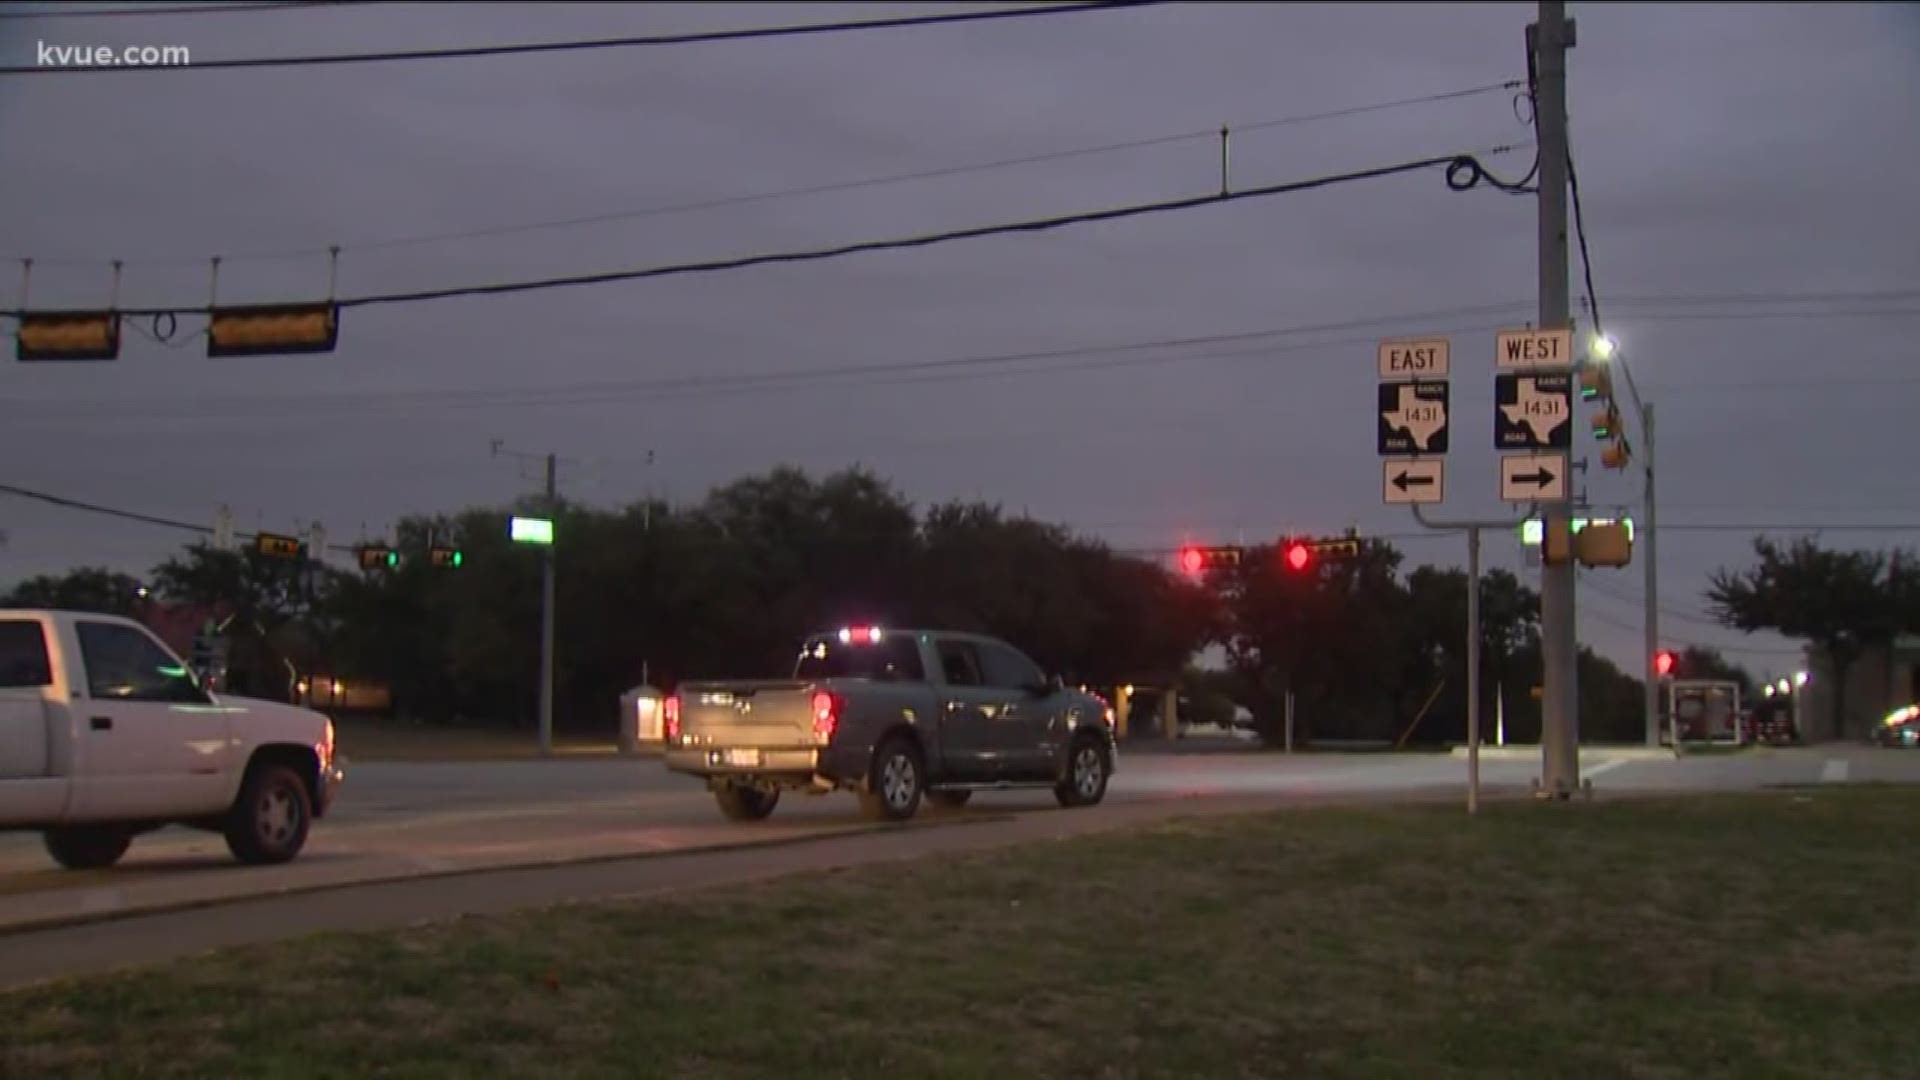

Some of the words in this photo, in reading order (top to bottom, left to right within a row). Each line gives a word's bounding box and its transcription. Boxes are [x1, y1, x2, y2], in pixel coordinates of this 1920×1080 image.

[1507, 337, 1559, 360] WEST
[1390, 349, 1437, 371] EAST
[1405, 407, 1437, 422] 1431
[1524, 401, 1559, 416] 1431
